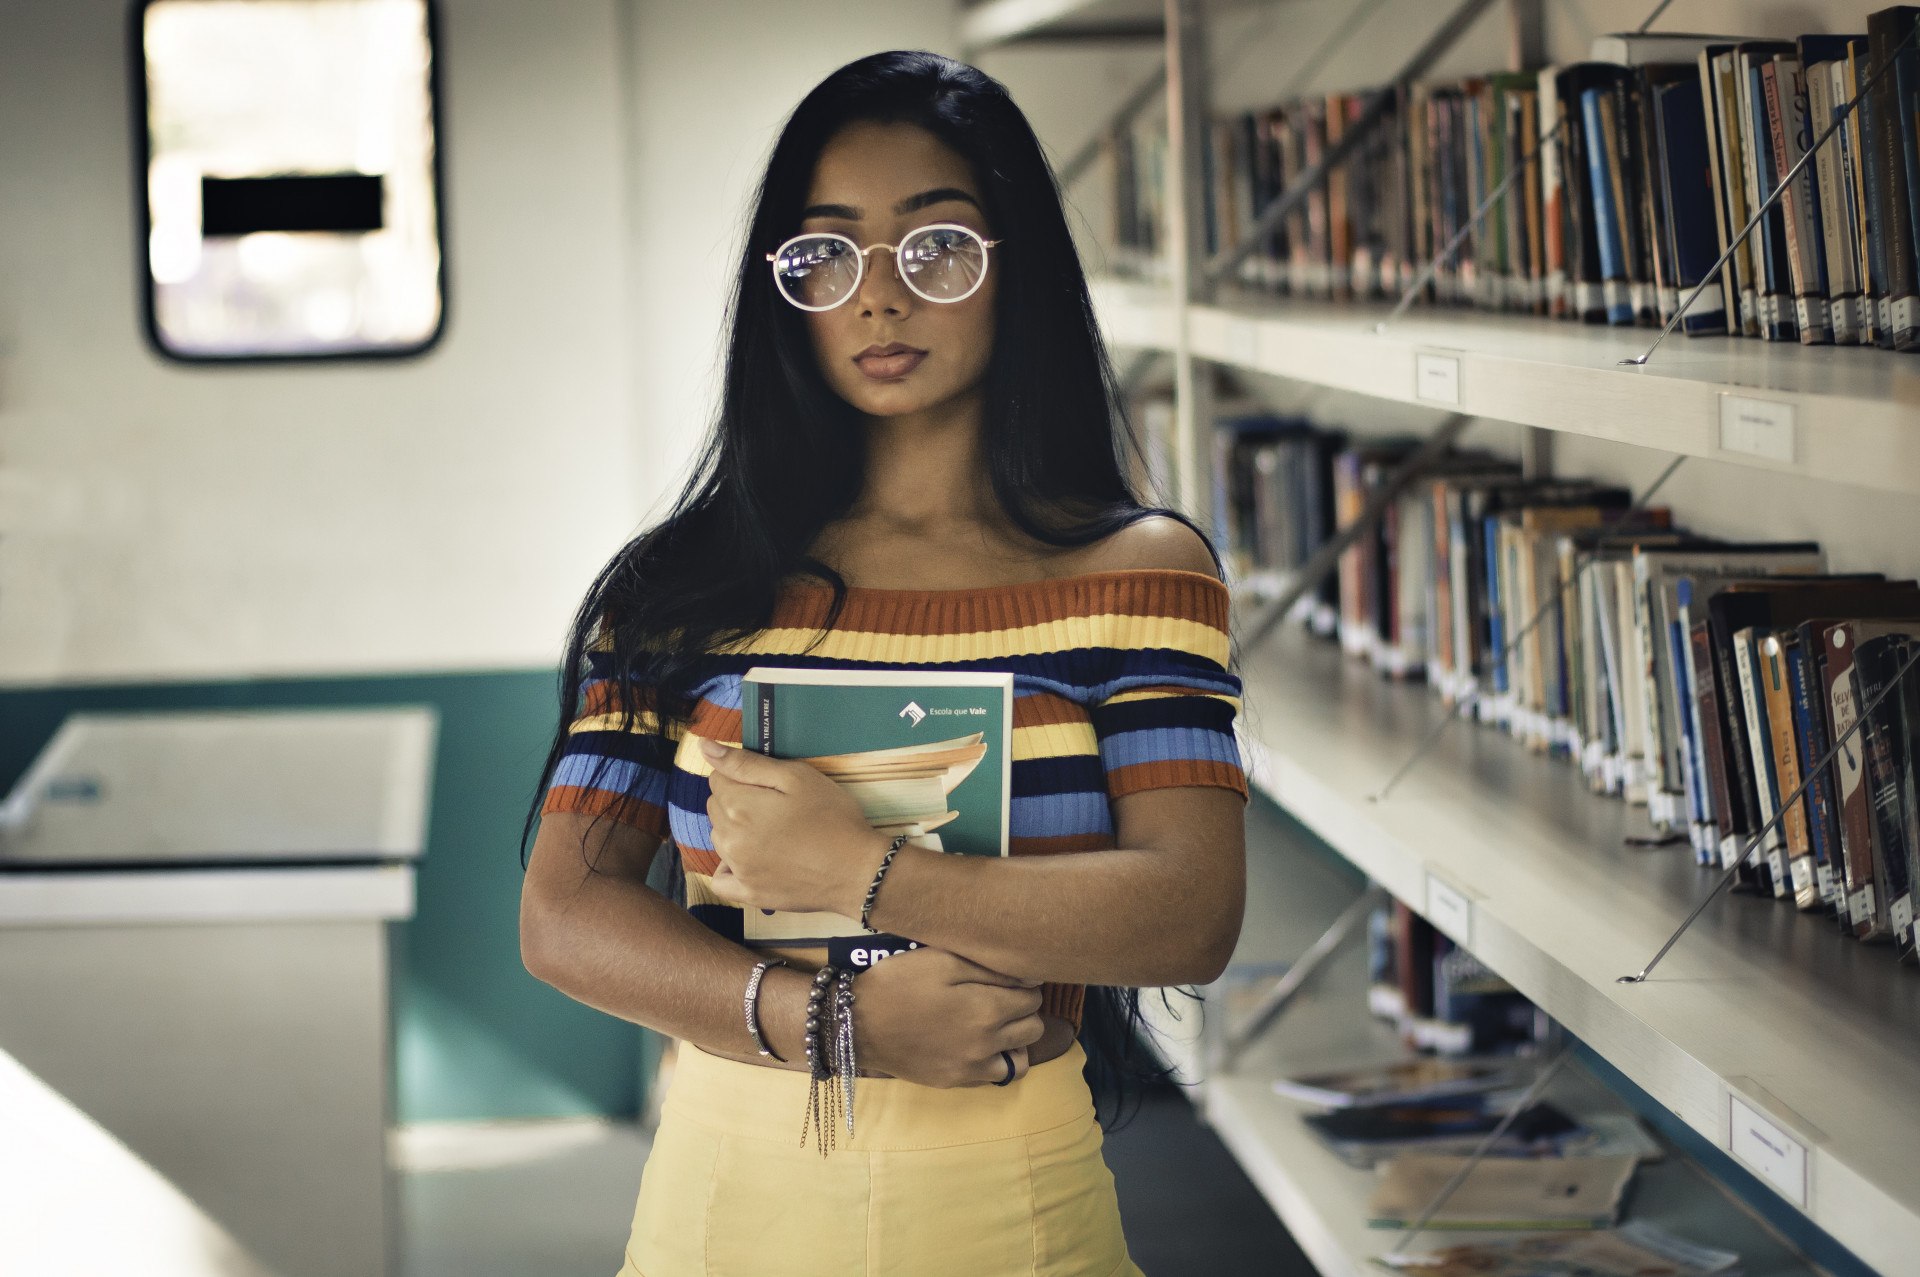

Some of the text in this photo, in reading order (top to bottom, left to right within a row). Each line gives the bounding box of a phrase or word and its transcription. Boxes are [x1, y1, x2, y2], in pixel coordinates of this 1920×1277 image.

[1765, 74, 1780, 130] Fernando
[930, 707, 987, 717] Escola que Vale
